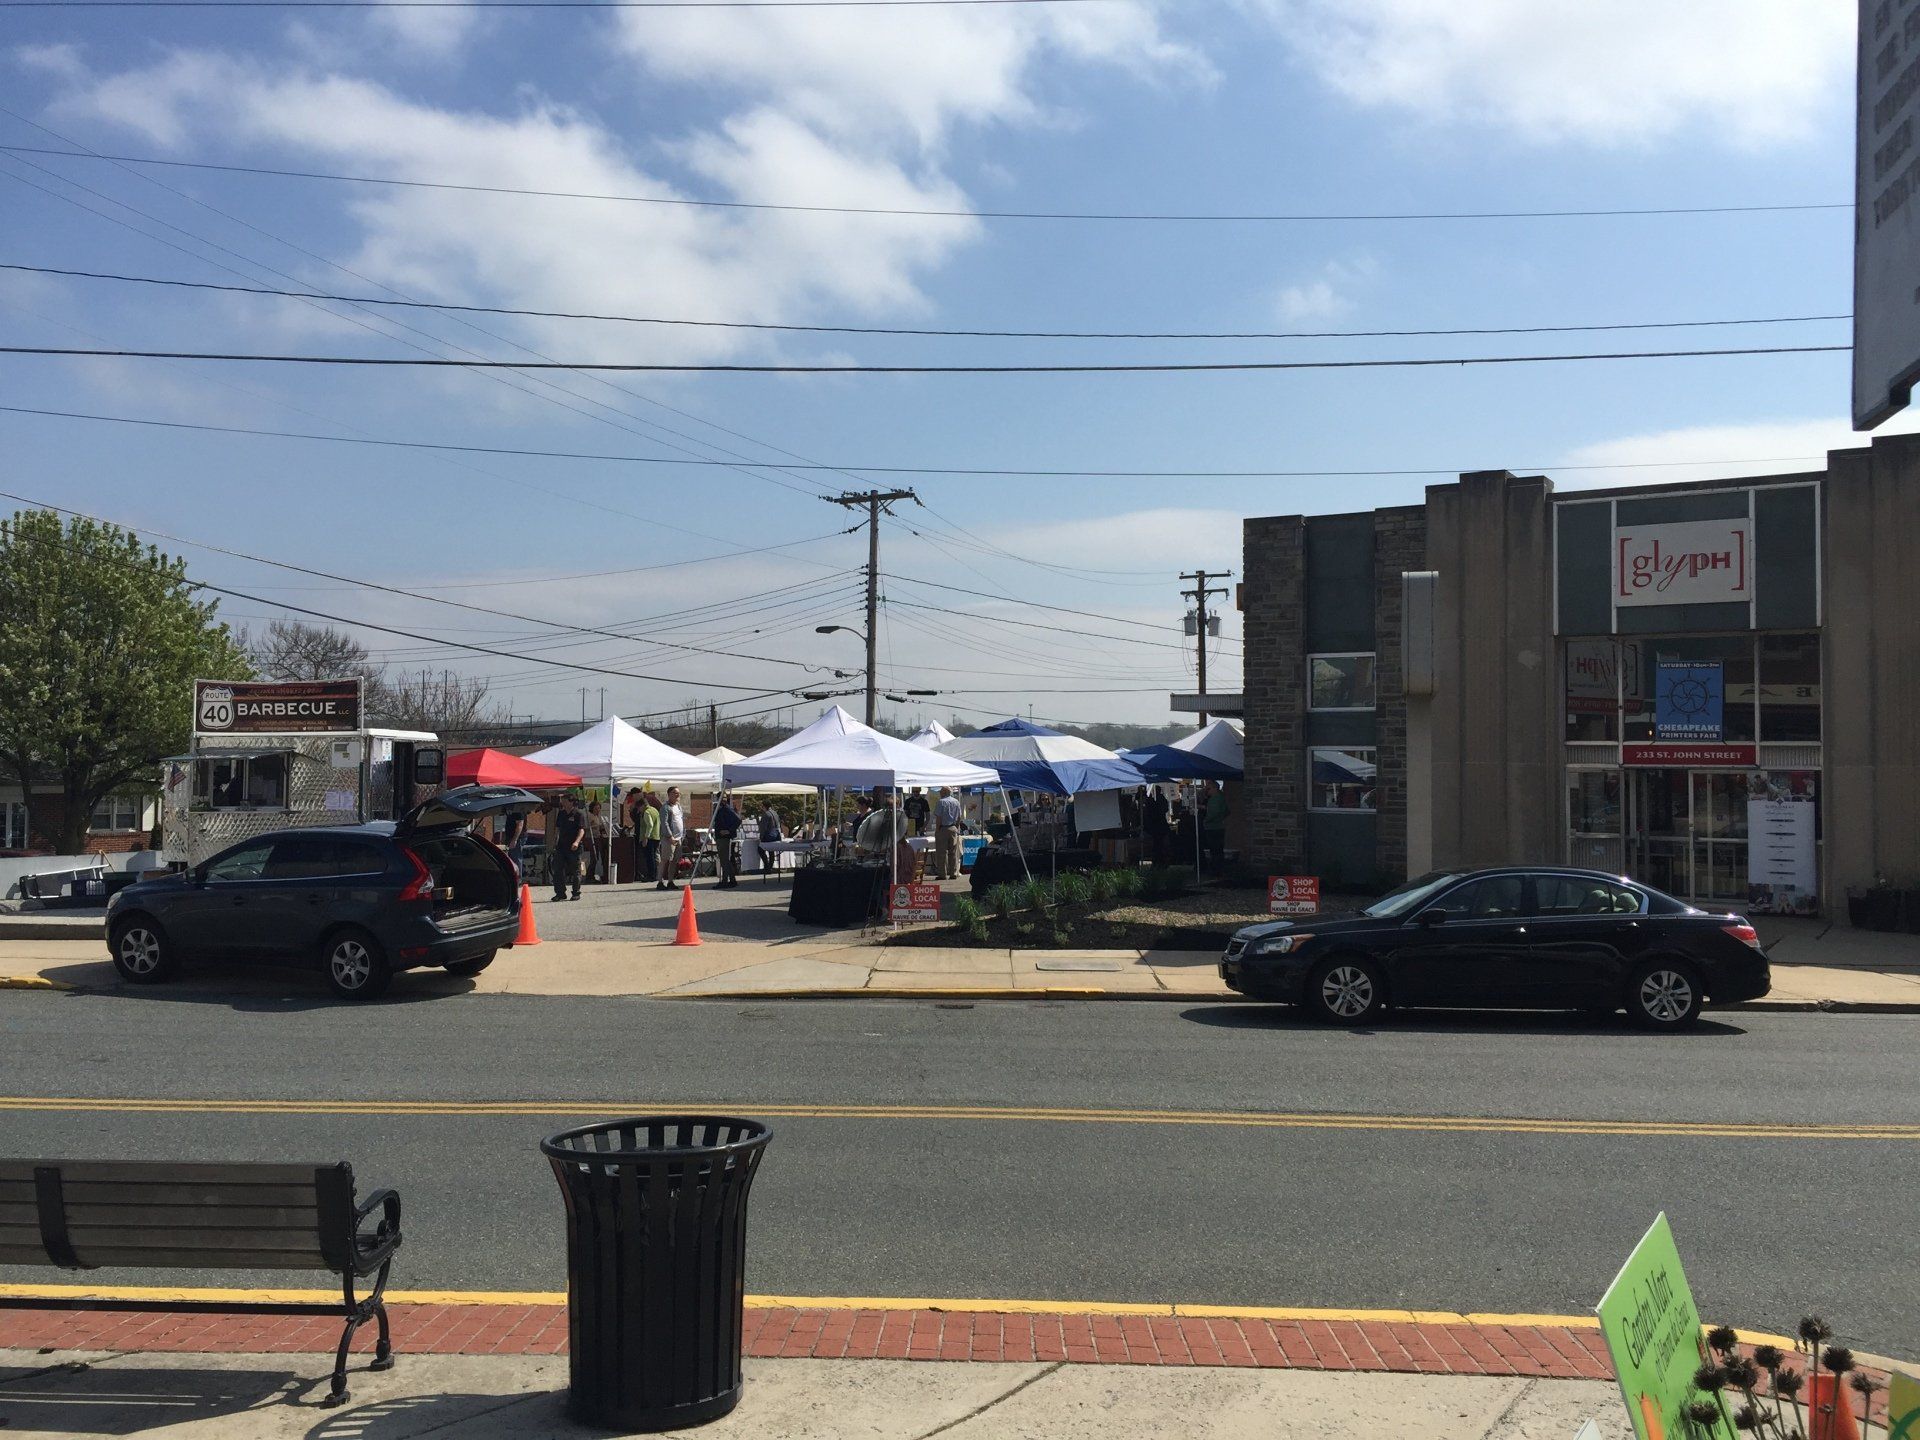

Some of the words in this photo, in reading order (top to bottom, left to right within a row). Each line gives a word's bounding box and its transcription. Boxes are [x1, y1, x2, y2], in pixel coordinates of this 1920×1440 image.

[203, 705, 229, 723] 40
[237, 702, 336, 716] BARBECUE
[1658, 724, 1720, 732] CHESAPEAKE
[1656, 751, 1671, 759] ST.
[1672, 751, 1701, 759] JOHN
[1703, 751, 1742, 759] STREET
[1293, 887, 1317, 895] LOCAL
[1622, 1288, 1657, 1370] Garden
[1645, 1264, 1674, 1323] Mart
[1653, 1341, 1669, 1395] of
